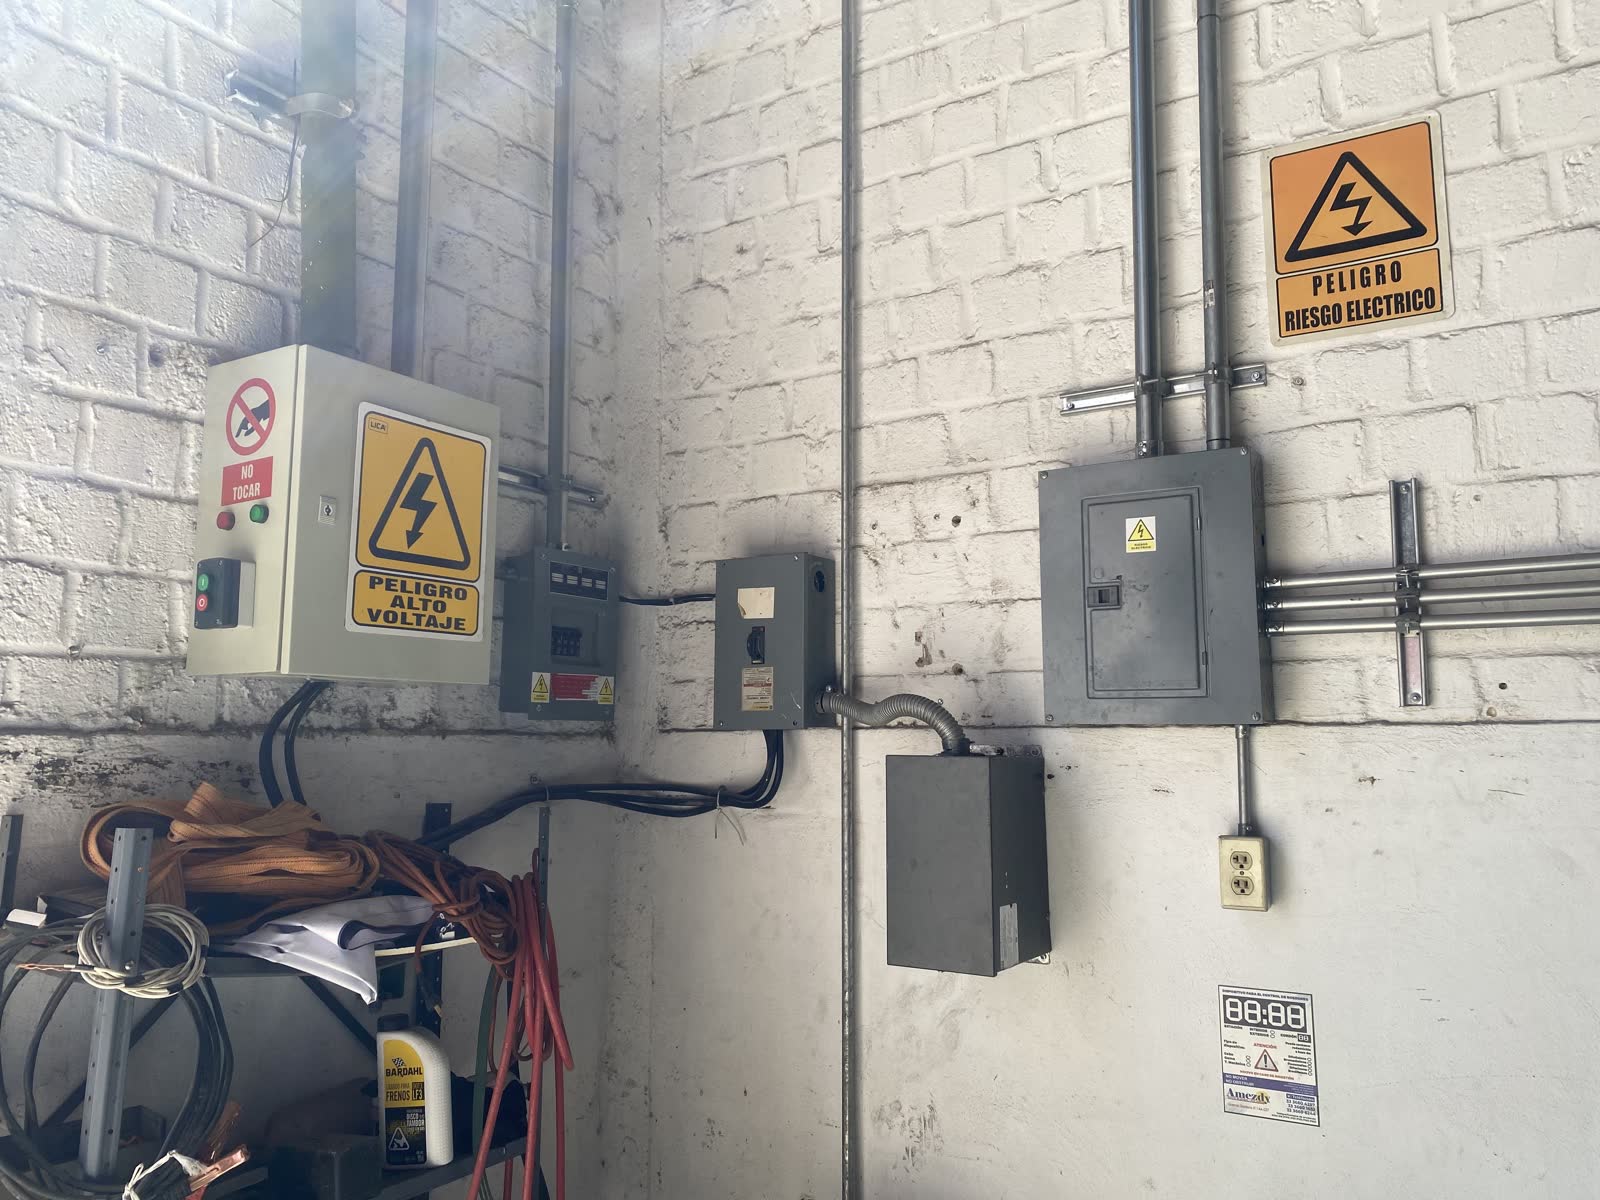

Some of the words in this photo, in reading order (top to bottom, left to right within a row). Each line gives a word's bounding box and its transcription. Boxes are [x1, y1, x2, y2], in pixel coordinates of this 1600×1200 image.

[1312, 260, 1401, 296] PELIGRO
[1285, 302, 1342, 332] RIESGO
[1346, 286, 1436, 322] ELECTRICO
[241, 464, 254, 480] NO
[232, 482, 261, 501] TOCAR
[369, 575, 467, 600] PELIGRO
[390, 595, 447, 613] ALTO
[367, 608, 466, 631] VOLTAJE
[1225, 997, 1305, 1029] 88:88
[386, 1066, 423, 1078] BARDAHL
[386, 1090, 410, 1102] FRENOS
